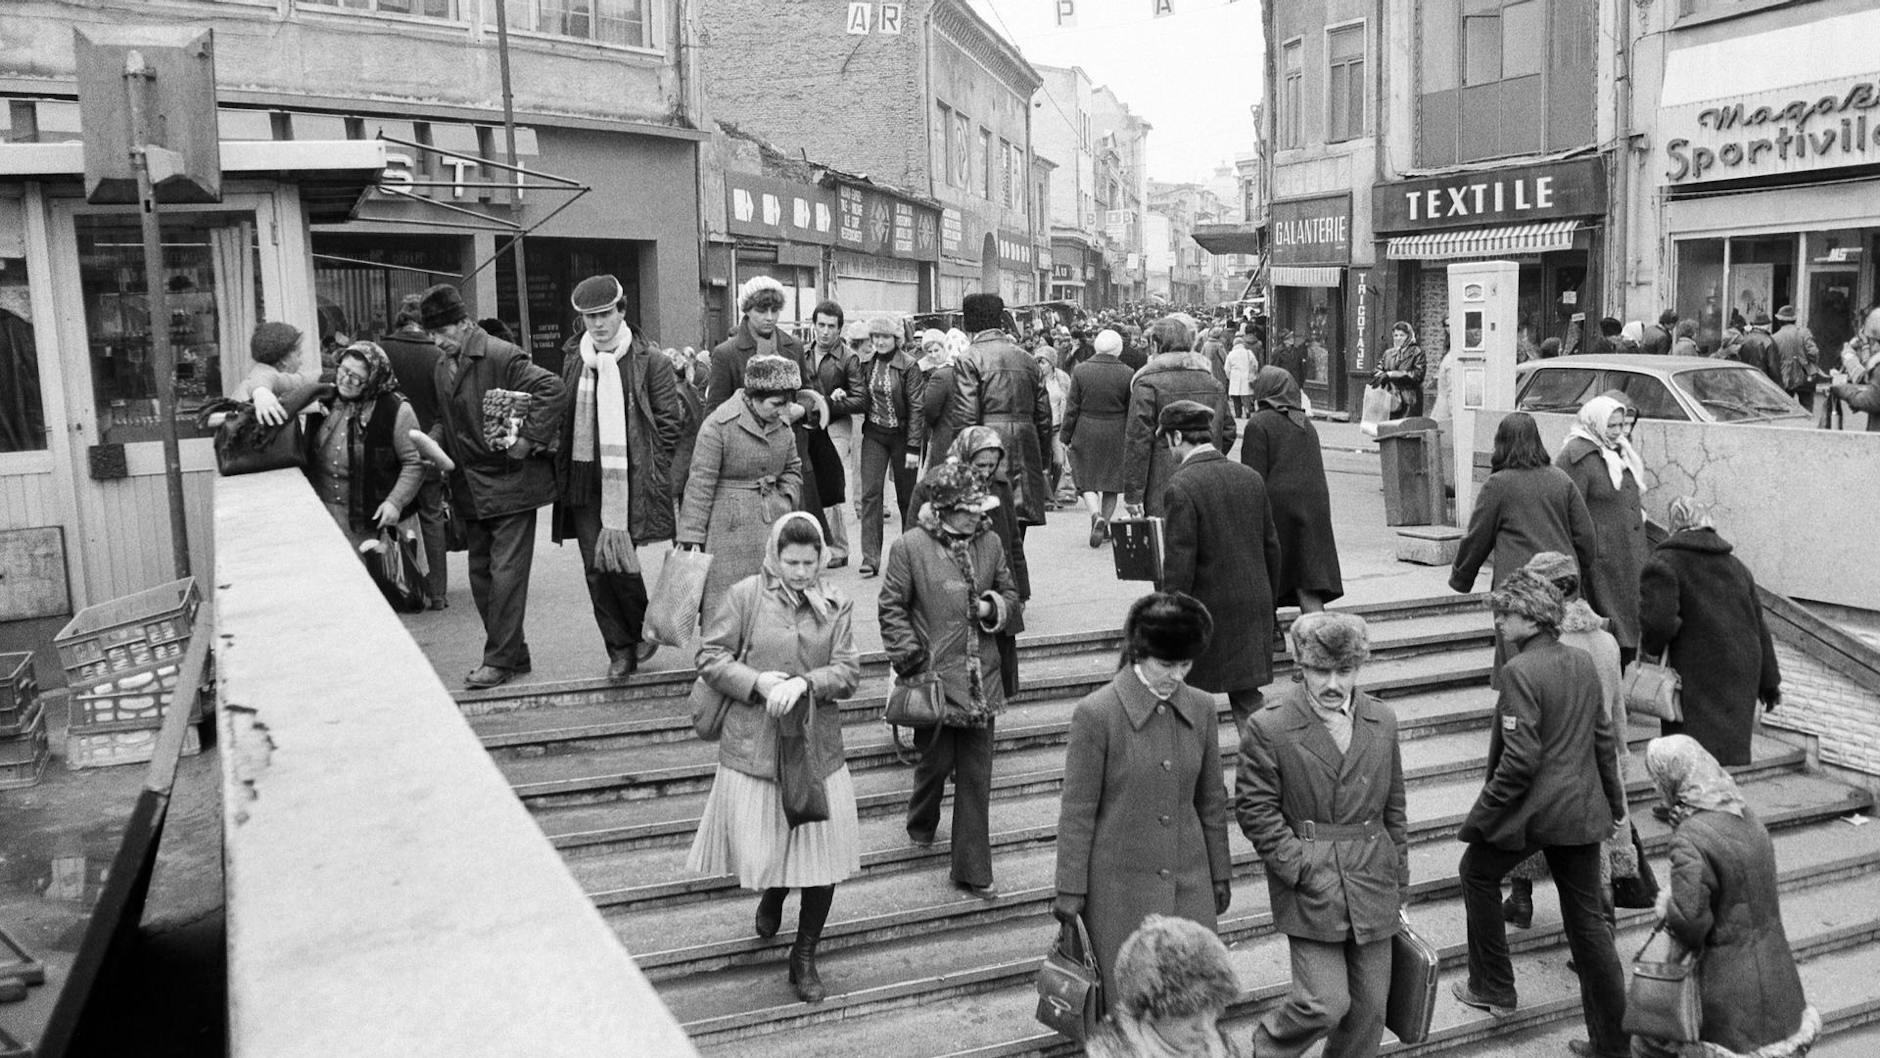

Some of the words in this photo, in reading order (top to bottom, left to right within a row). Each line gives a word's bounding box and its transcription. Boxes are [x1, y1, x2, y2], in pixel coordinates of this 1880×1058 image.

[1698, 81, 1880, 133] Magaz
[1406, 176, 1553, 221] TEXTILE
[1276, 216, 1346, 246] GALANTERIE
[1356, 273, 1367, 370] TRICOTAJE
